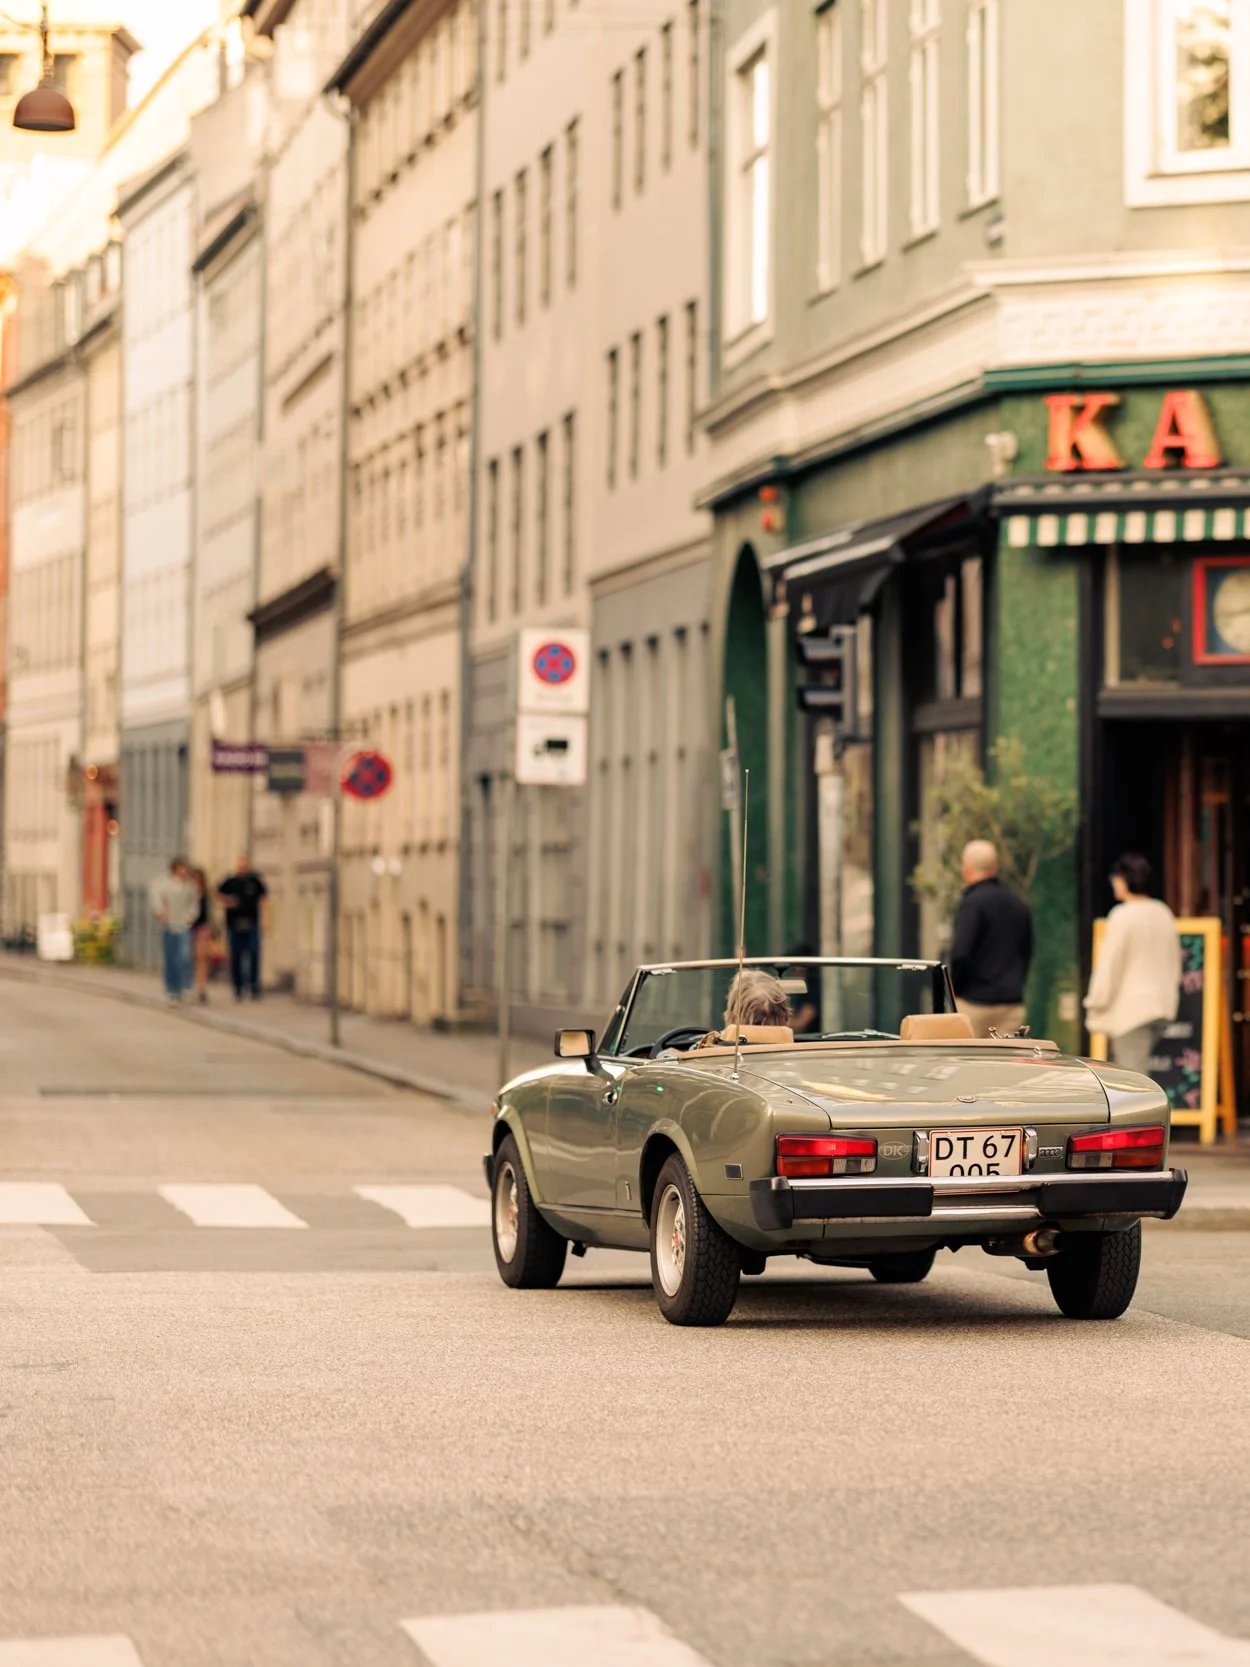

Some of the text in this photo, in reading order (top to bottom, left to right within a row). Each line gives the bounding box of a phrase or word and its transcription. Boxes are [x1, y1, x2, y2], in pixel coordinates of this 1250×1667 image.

[883, 1146, 904, 1157] DK
[936, 1135, 1016, 1160] DT 67
[1039, 1149, 1062, 1157] 2000
